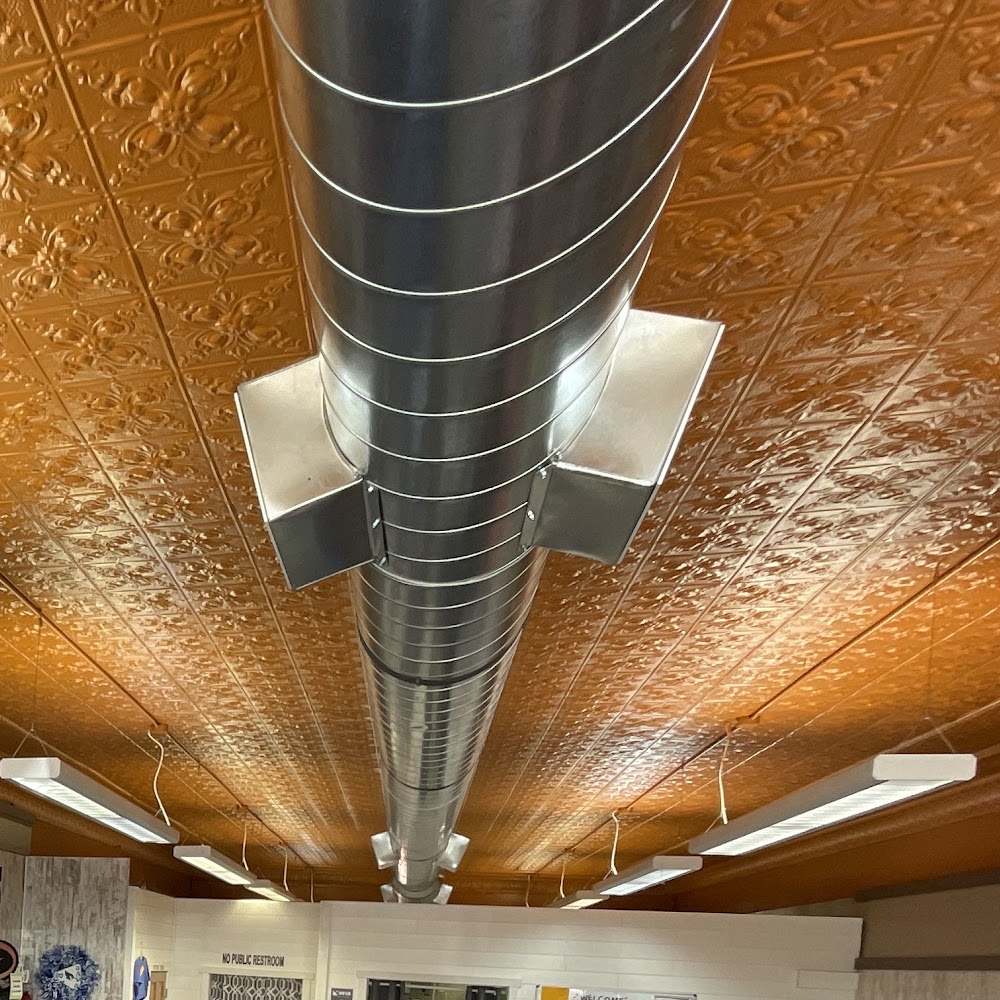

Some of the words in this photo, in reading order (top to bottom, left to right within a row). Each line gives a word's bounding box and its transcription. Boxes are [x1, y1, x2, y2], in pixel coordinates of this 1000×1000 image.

[221, 952, 231, 964] NO
[231, 953, 252, 966] PUBLIC
[252, 954, 285, 967] RESTROOM
